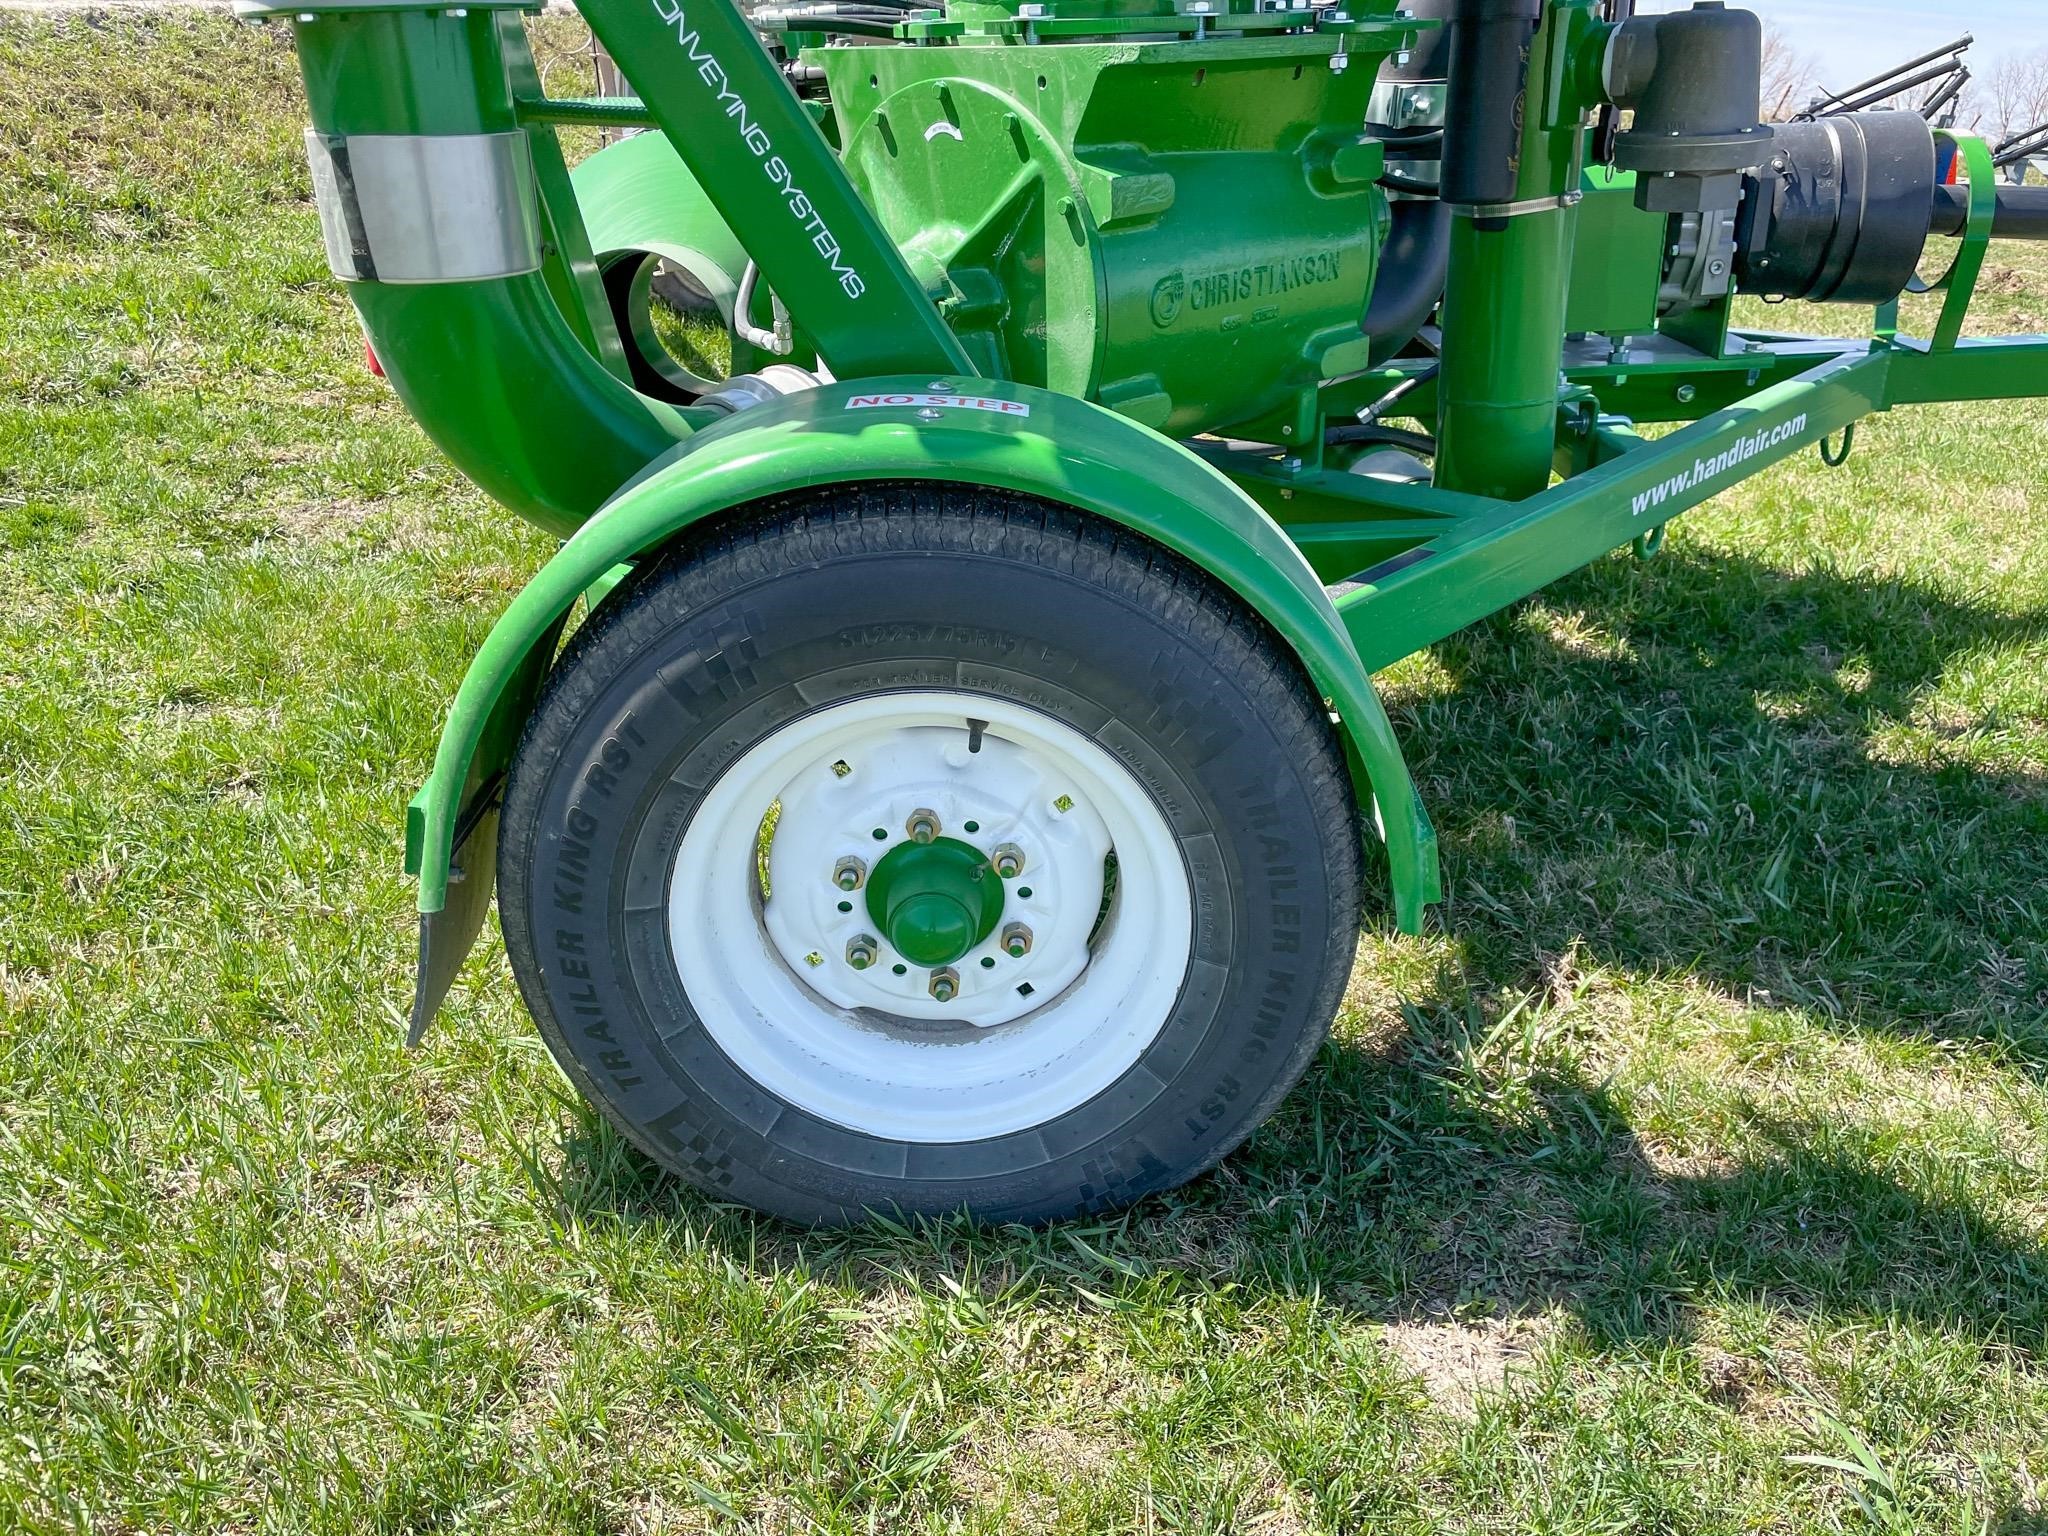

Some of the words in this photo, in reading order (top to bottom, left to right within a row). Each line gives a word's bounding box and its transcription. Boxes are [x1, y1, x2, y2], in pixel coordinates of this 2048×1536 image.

[763, 155, 866, 300] SYSTEMS
[1190, 250, 1341, 311] CHRISTIANSON
[851, 395, 914, 408] NO
[928, 396, 1024, 412] STEP
[1631, 412, 1807, 517] www.handlair.com
[960, 675, 1021, 697] SERVICE
[584, 710, 647, 800] RST
[553, 805, 601, 915] KING
[1234, 776, 1302, 954] TRAILER
[555, 928, 646, 1094] TRAILER
[1239, 968, 1297, 1065] KING
[1184, 1071, 1242, 1142] RST
